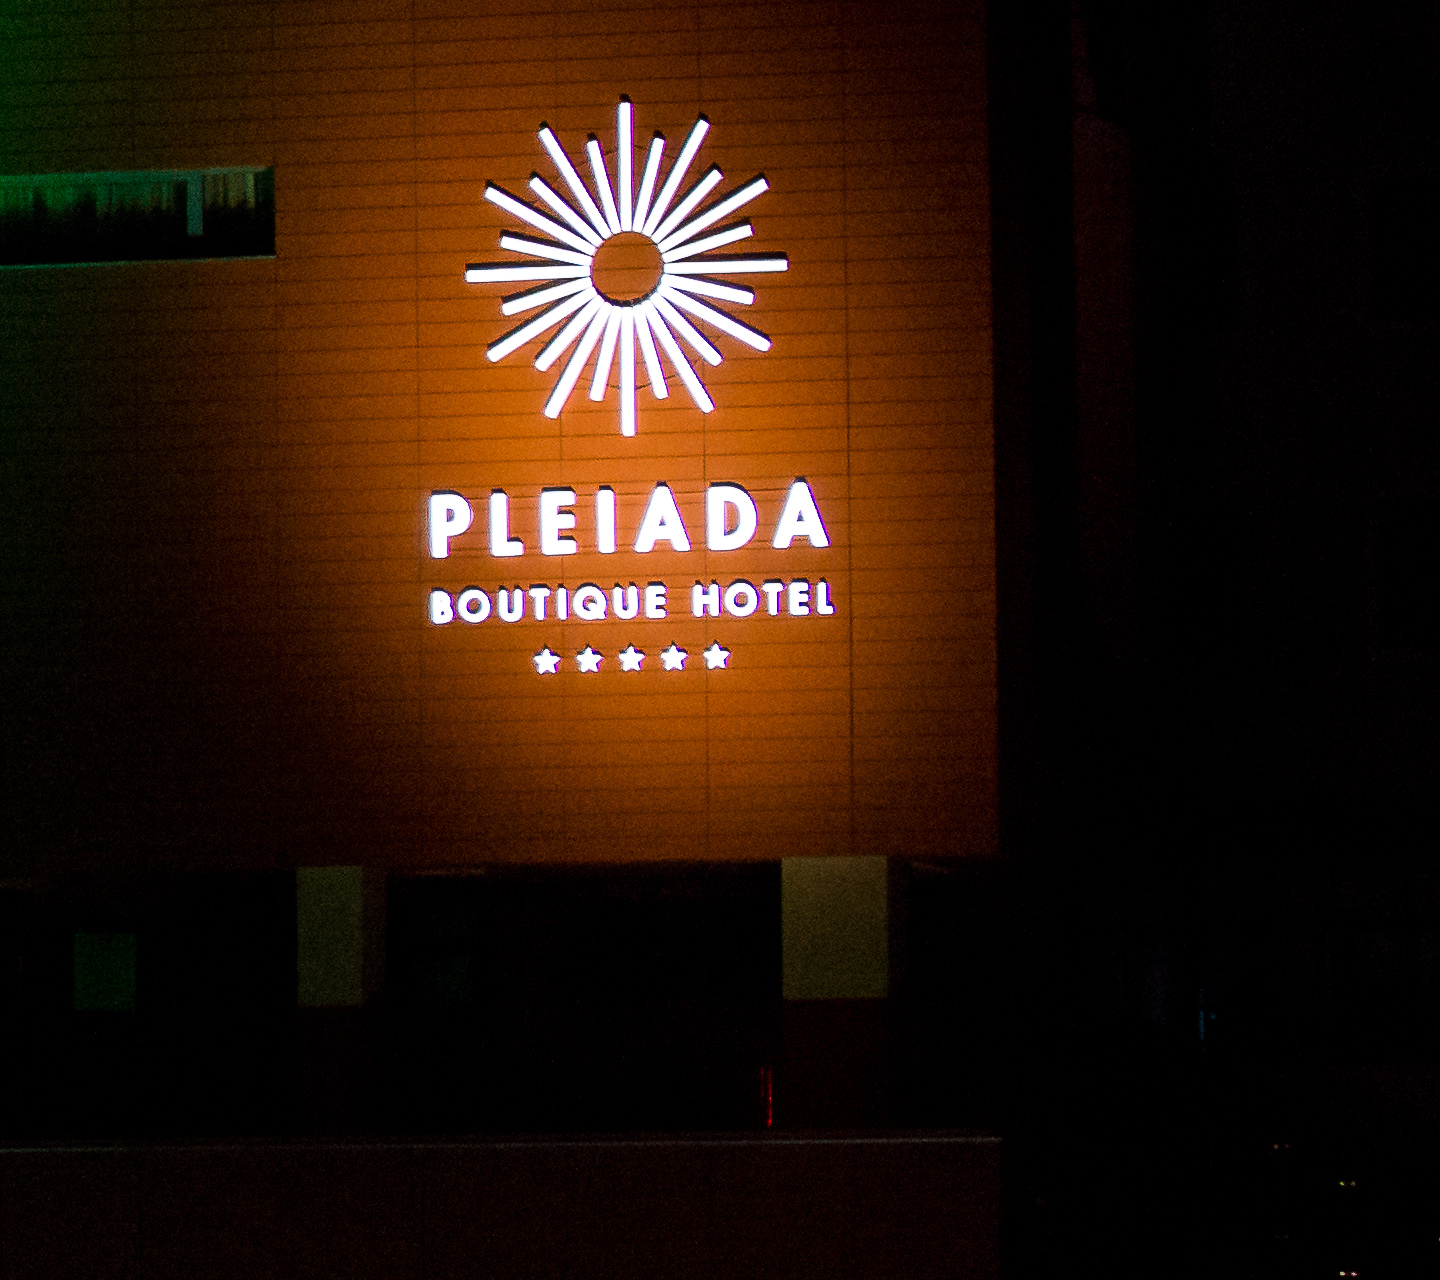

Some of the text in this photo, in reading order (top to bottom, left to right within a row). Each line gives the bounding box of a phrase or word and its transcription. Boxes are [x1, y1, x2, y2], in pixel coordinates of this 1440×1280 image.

[427, 478, 832, 559] PLEIADA
[429, 579, 837, 625] BOUTIQUE HOTEL
